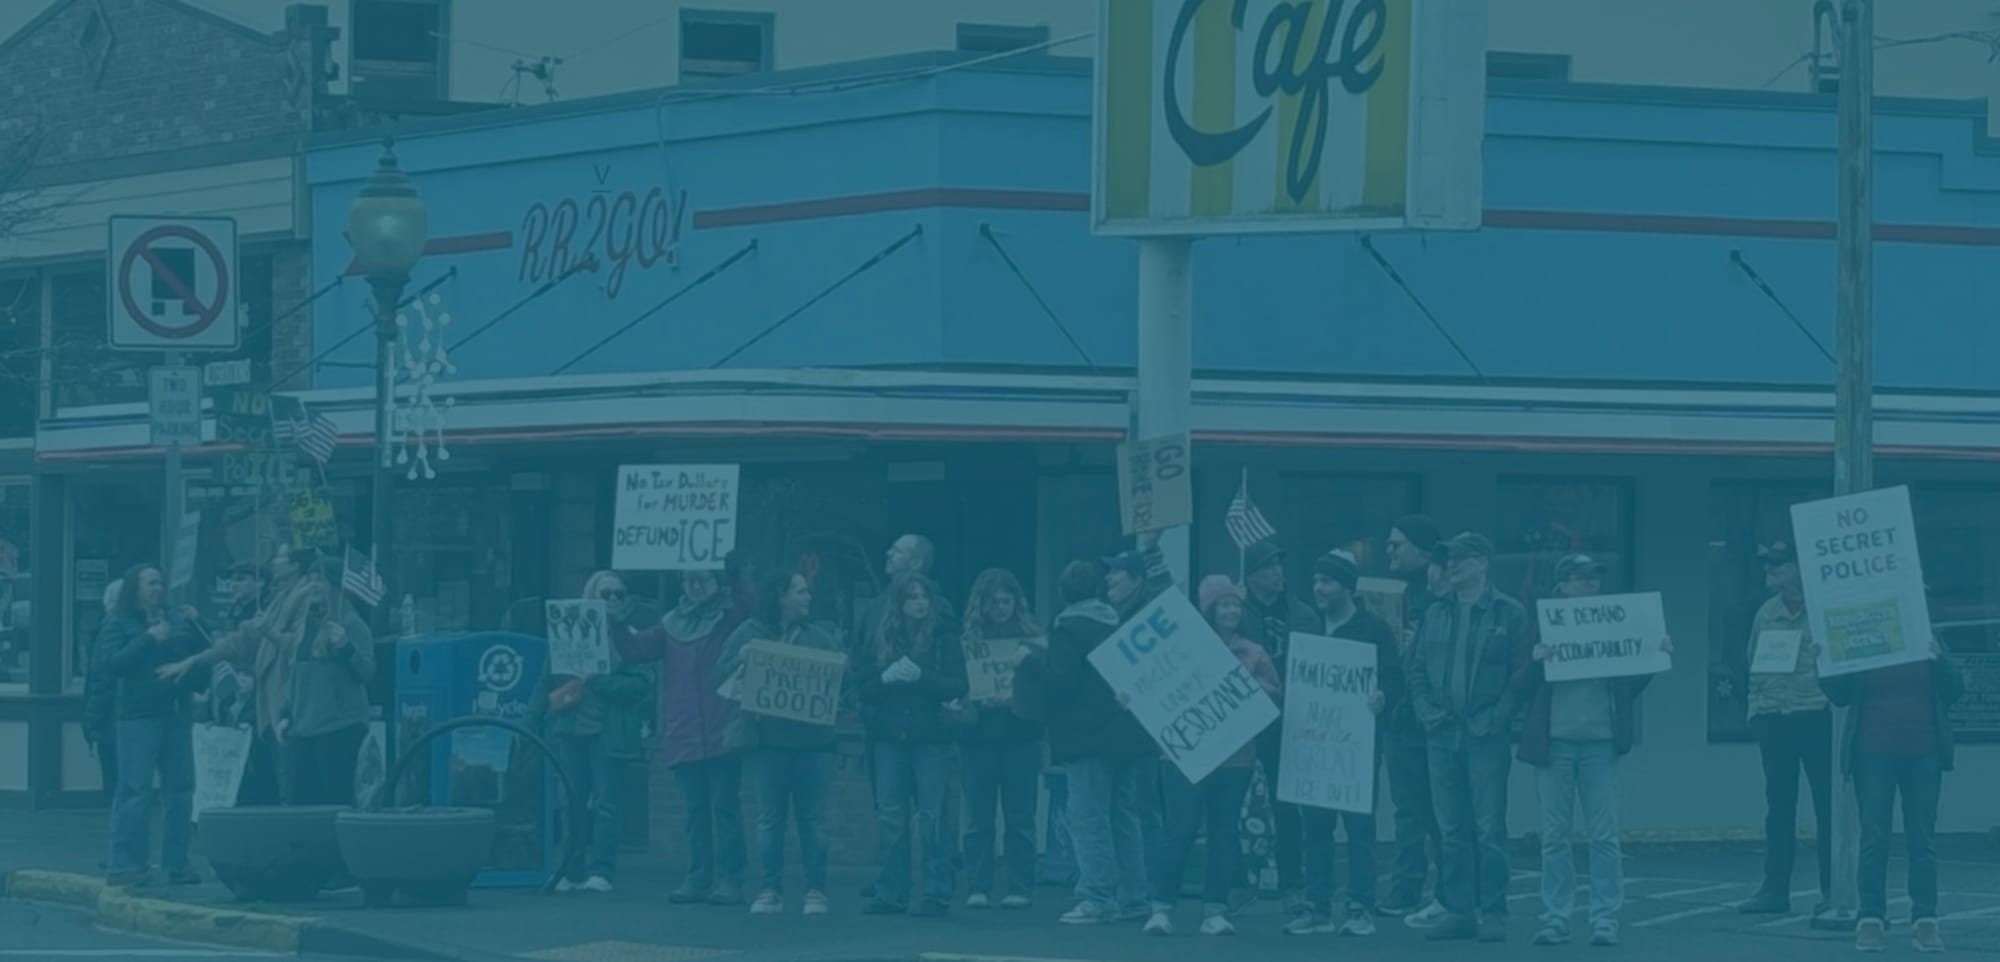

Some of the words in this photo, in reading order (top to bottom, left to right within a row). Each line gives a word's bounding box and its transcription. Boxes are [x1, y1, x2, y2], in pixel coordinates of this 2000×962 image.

[1154, 445, 1185, 480] GO
[626, 471, 649, 492] No
[651, 470, 673, 490] Tax
[678, 471, 729, 489] Dollars
[663, 492, 730, 513] MURDER
[1835, 506, 1871, 529] NO
[616, 525, 679, 547] DEFUND
[677, 518, 730, 563] ICE
[1815, 526, 1897, 557] SECRET
[1820, 553, 1898, 582] POLICE
[1545, 608, 1566, 627] WE
[1573, 603, 1626, 627] DEMAND
[1117, 605, 1179, 665] ICE
[757, 687, 834, 721] GOOD!
